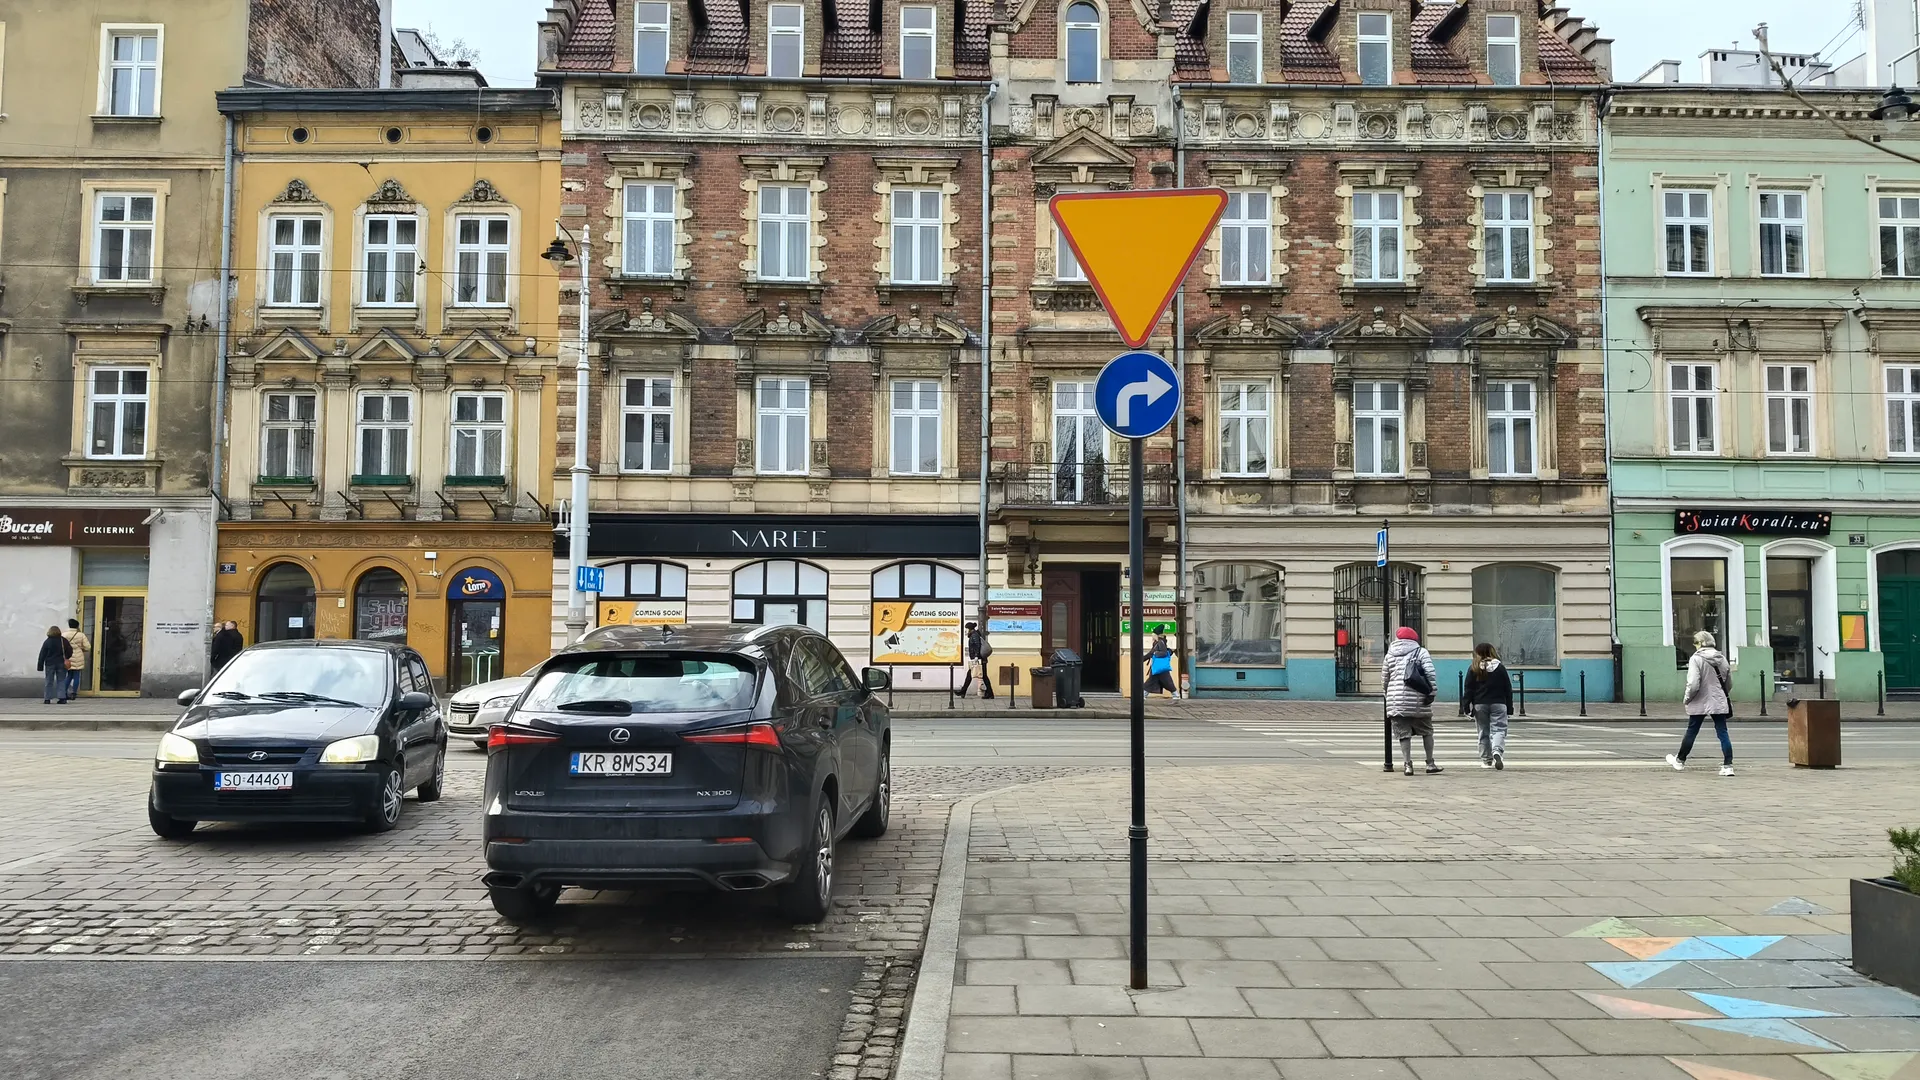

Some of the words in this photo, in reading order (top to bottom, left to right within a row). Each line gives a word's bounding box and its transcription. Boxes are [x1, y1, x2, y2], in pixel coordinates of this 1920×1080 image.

[0, 515, 53, 534] Buczek
[83, 526, 135, 534] CUKIERNIK
[731, 530, 827, 548] NAREE
[467, 583, 486, 592] LOTTO
[582, 755, 605, 771] KR
[612, 755, 668, 772] 8MS34
[247, 773, 289, 786] 4446Y
